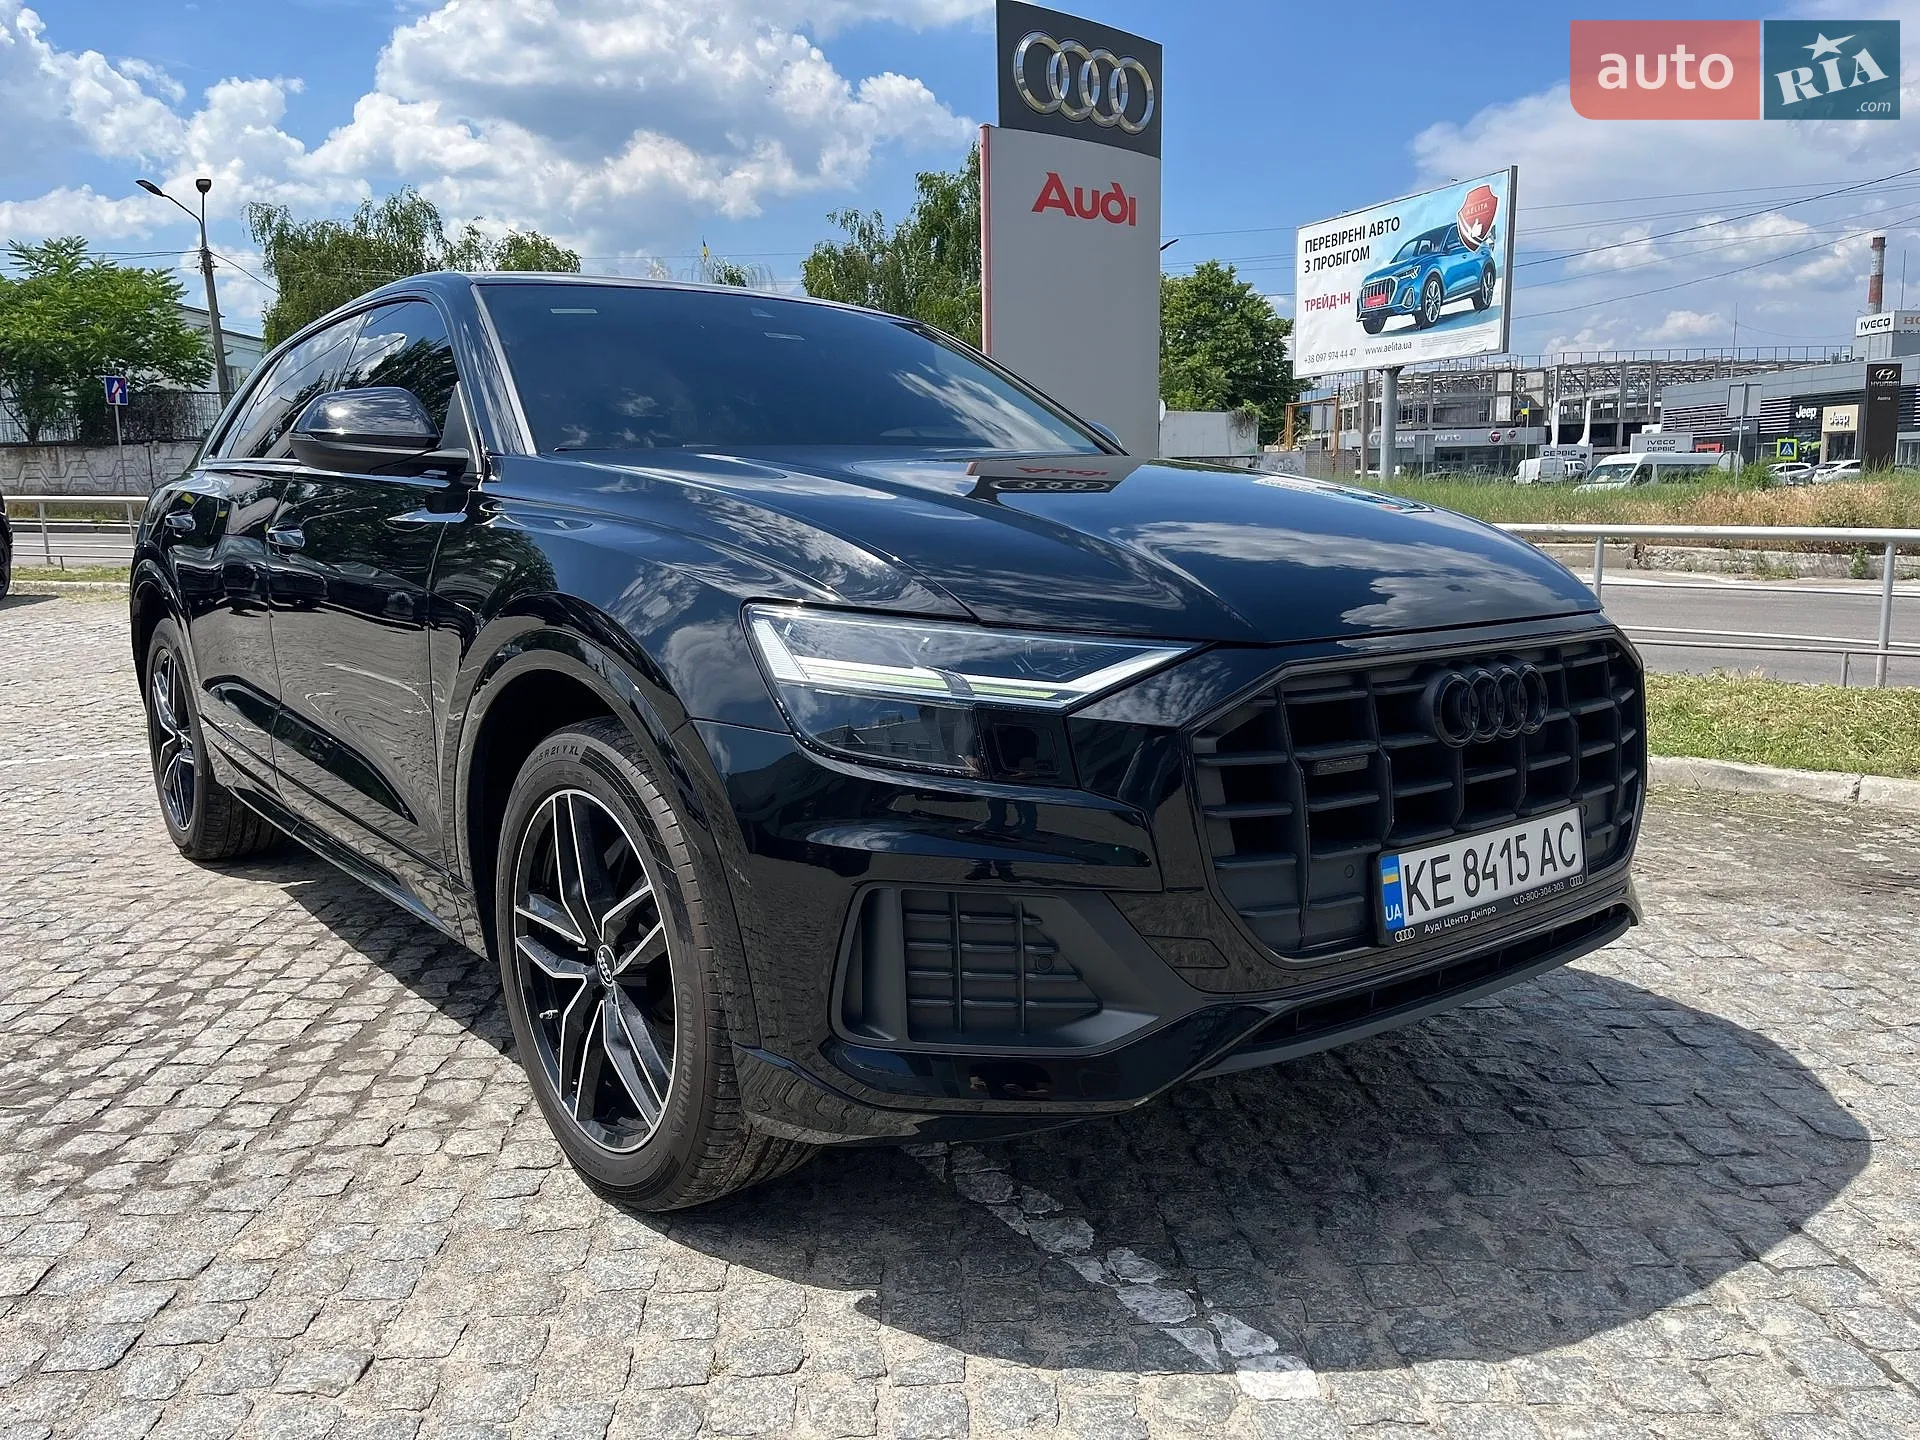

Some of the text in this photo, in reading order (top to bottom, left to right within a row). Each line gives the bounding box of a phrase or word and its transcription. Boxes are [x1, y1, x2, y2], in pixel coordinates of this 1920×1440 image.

[1031, 171, 1137, 227] Audi
[1466, 202, 1489, 215] AELITA
[1304, 216, 1401, 254] ПЕРЕВІРЕНІ АВТО
[1313, 245, 1370, 272] ПРОБІГОМ
[1304, 291, 1351, 312] ТРЕЙД-ІН
[1860, 317, 1891, 331] IVECO
[1364, 341, 1413, 356] www.aelita.ua
[1795, 405, 1818, 420] Jeep
[1829, 411, 1851, 428] Jeep
[1404, 821, 1577, 917] KE 8415 AC
[1385, 903, 1403, 922] UA
[1424, 905, 1497, 934] Ауді Центр Дніпро
